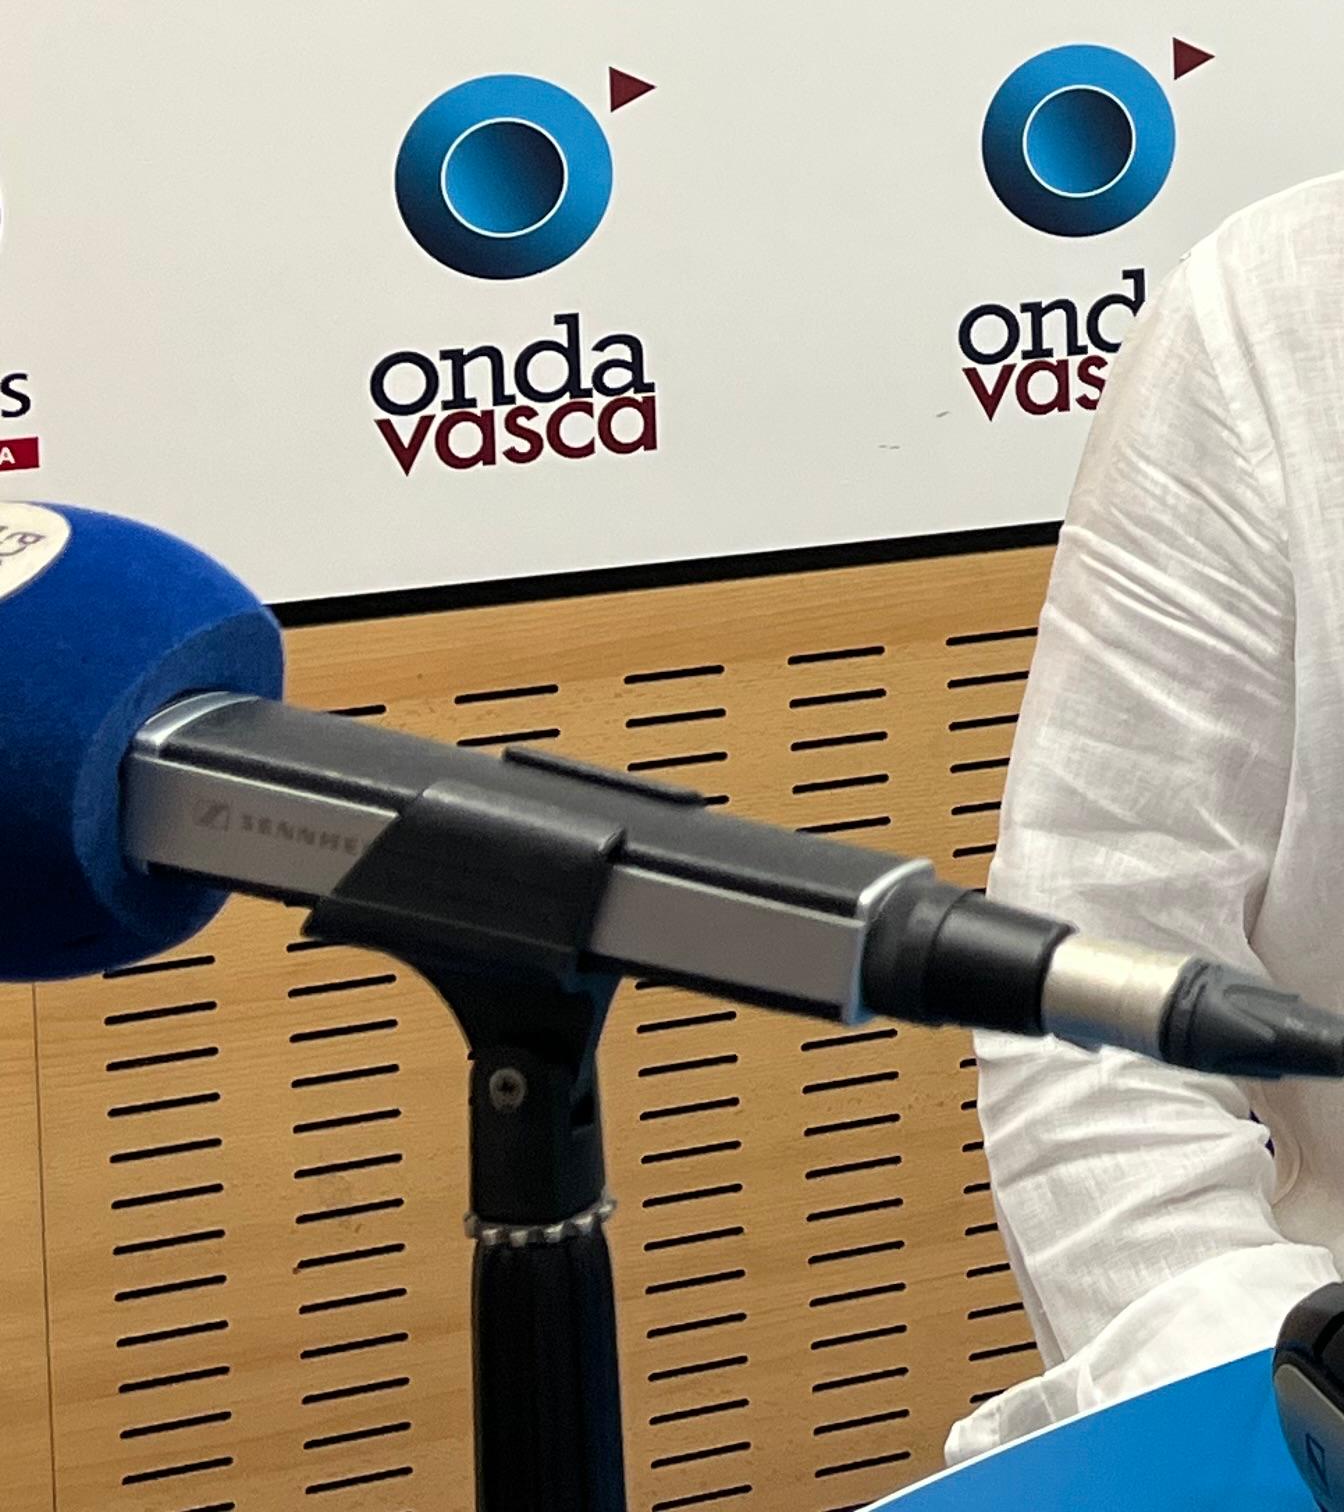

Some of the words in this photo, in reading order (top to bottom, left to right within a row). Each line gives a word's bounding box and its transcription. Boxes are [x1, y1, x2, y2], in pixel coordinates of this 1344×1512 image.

[958, 268, 1146, 365] ond
[369, 312, 656, 416] onda
[962, 355, 1109, 422] vas
[374, 395, 657, 476] vasca
